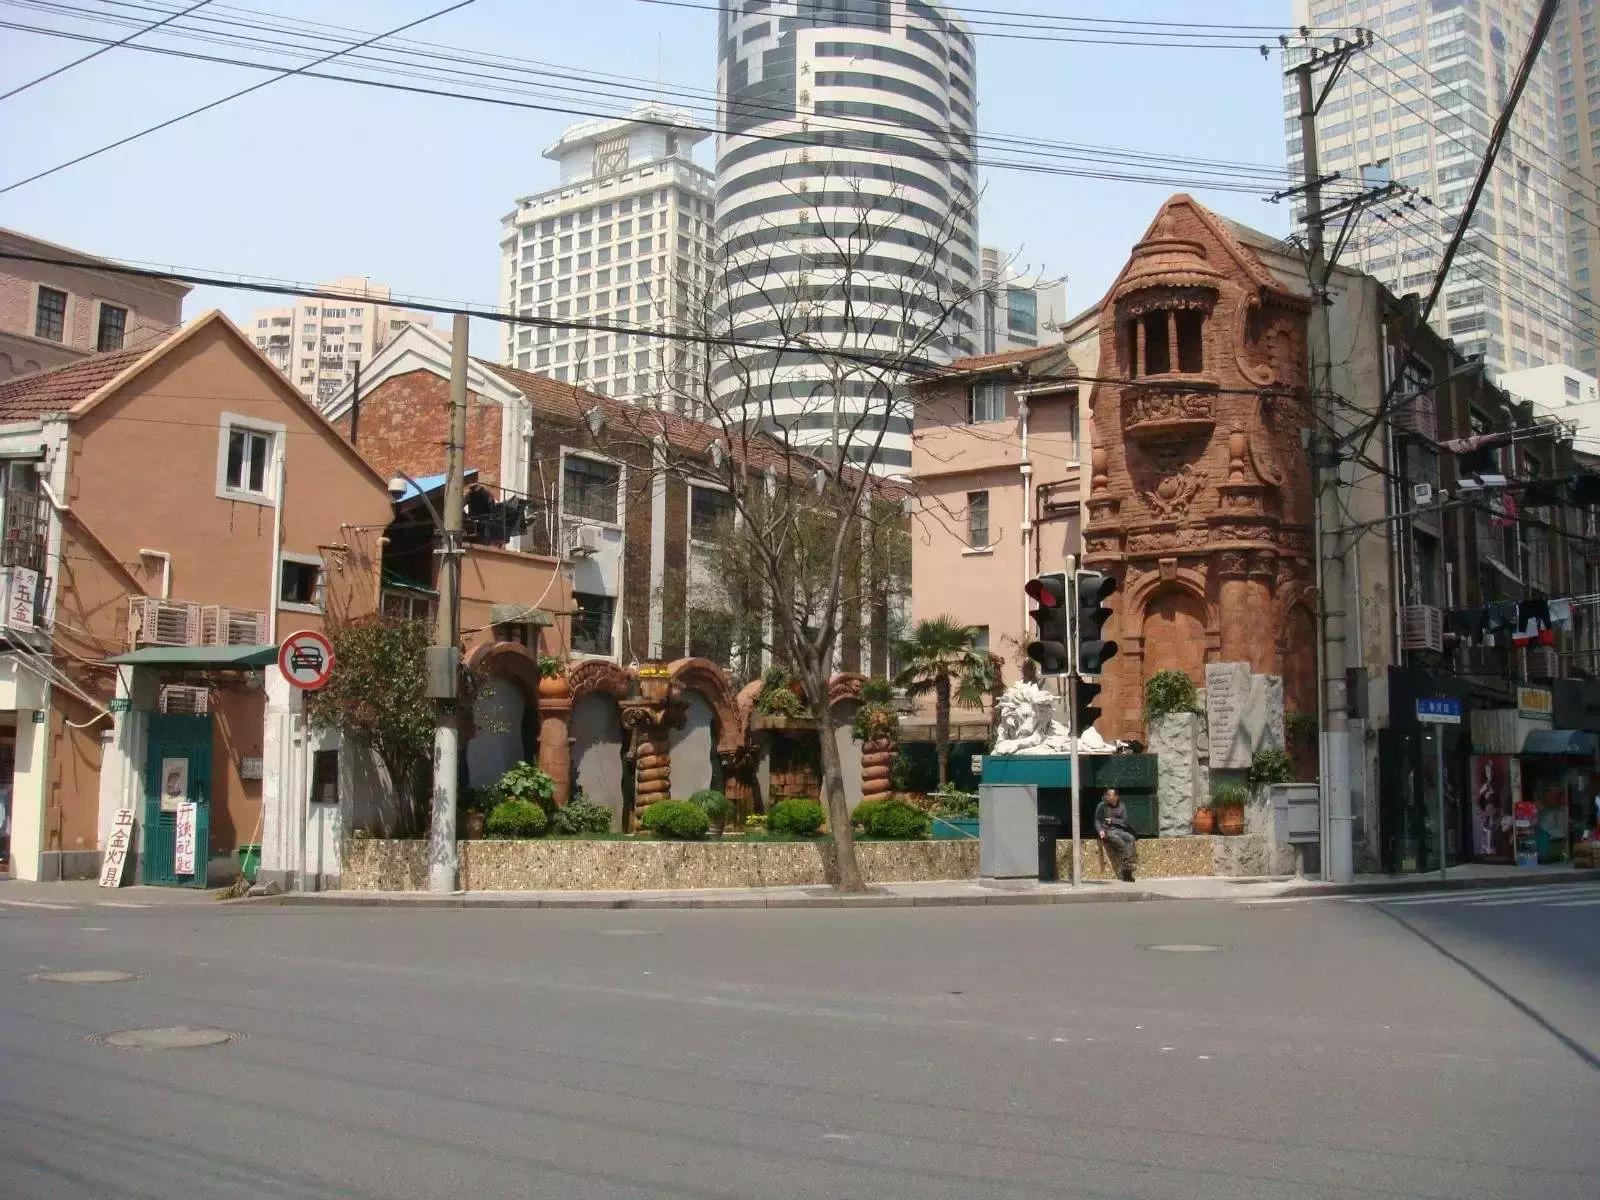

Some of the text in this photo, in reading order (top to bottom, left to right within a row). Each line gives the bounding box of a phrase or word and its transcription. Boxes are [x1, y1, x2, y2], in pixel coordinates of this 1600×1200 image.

[12, 585, 33, 623] 五金
[102, 810, 132, 886] 五金灯具
